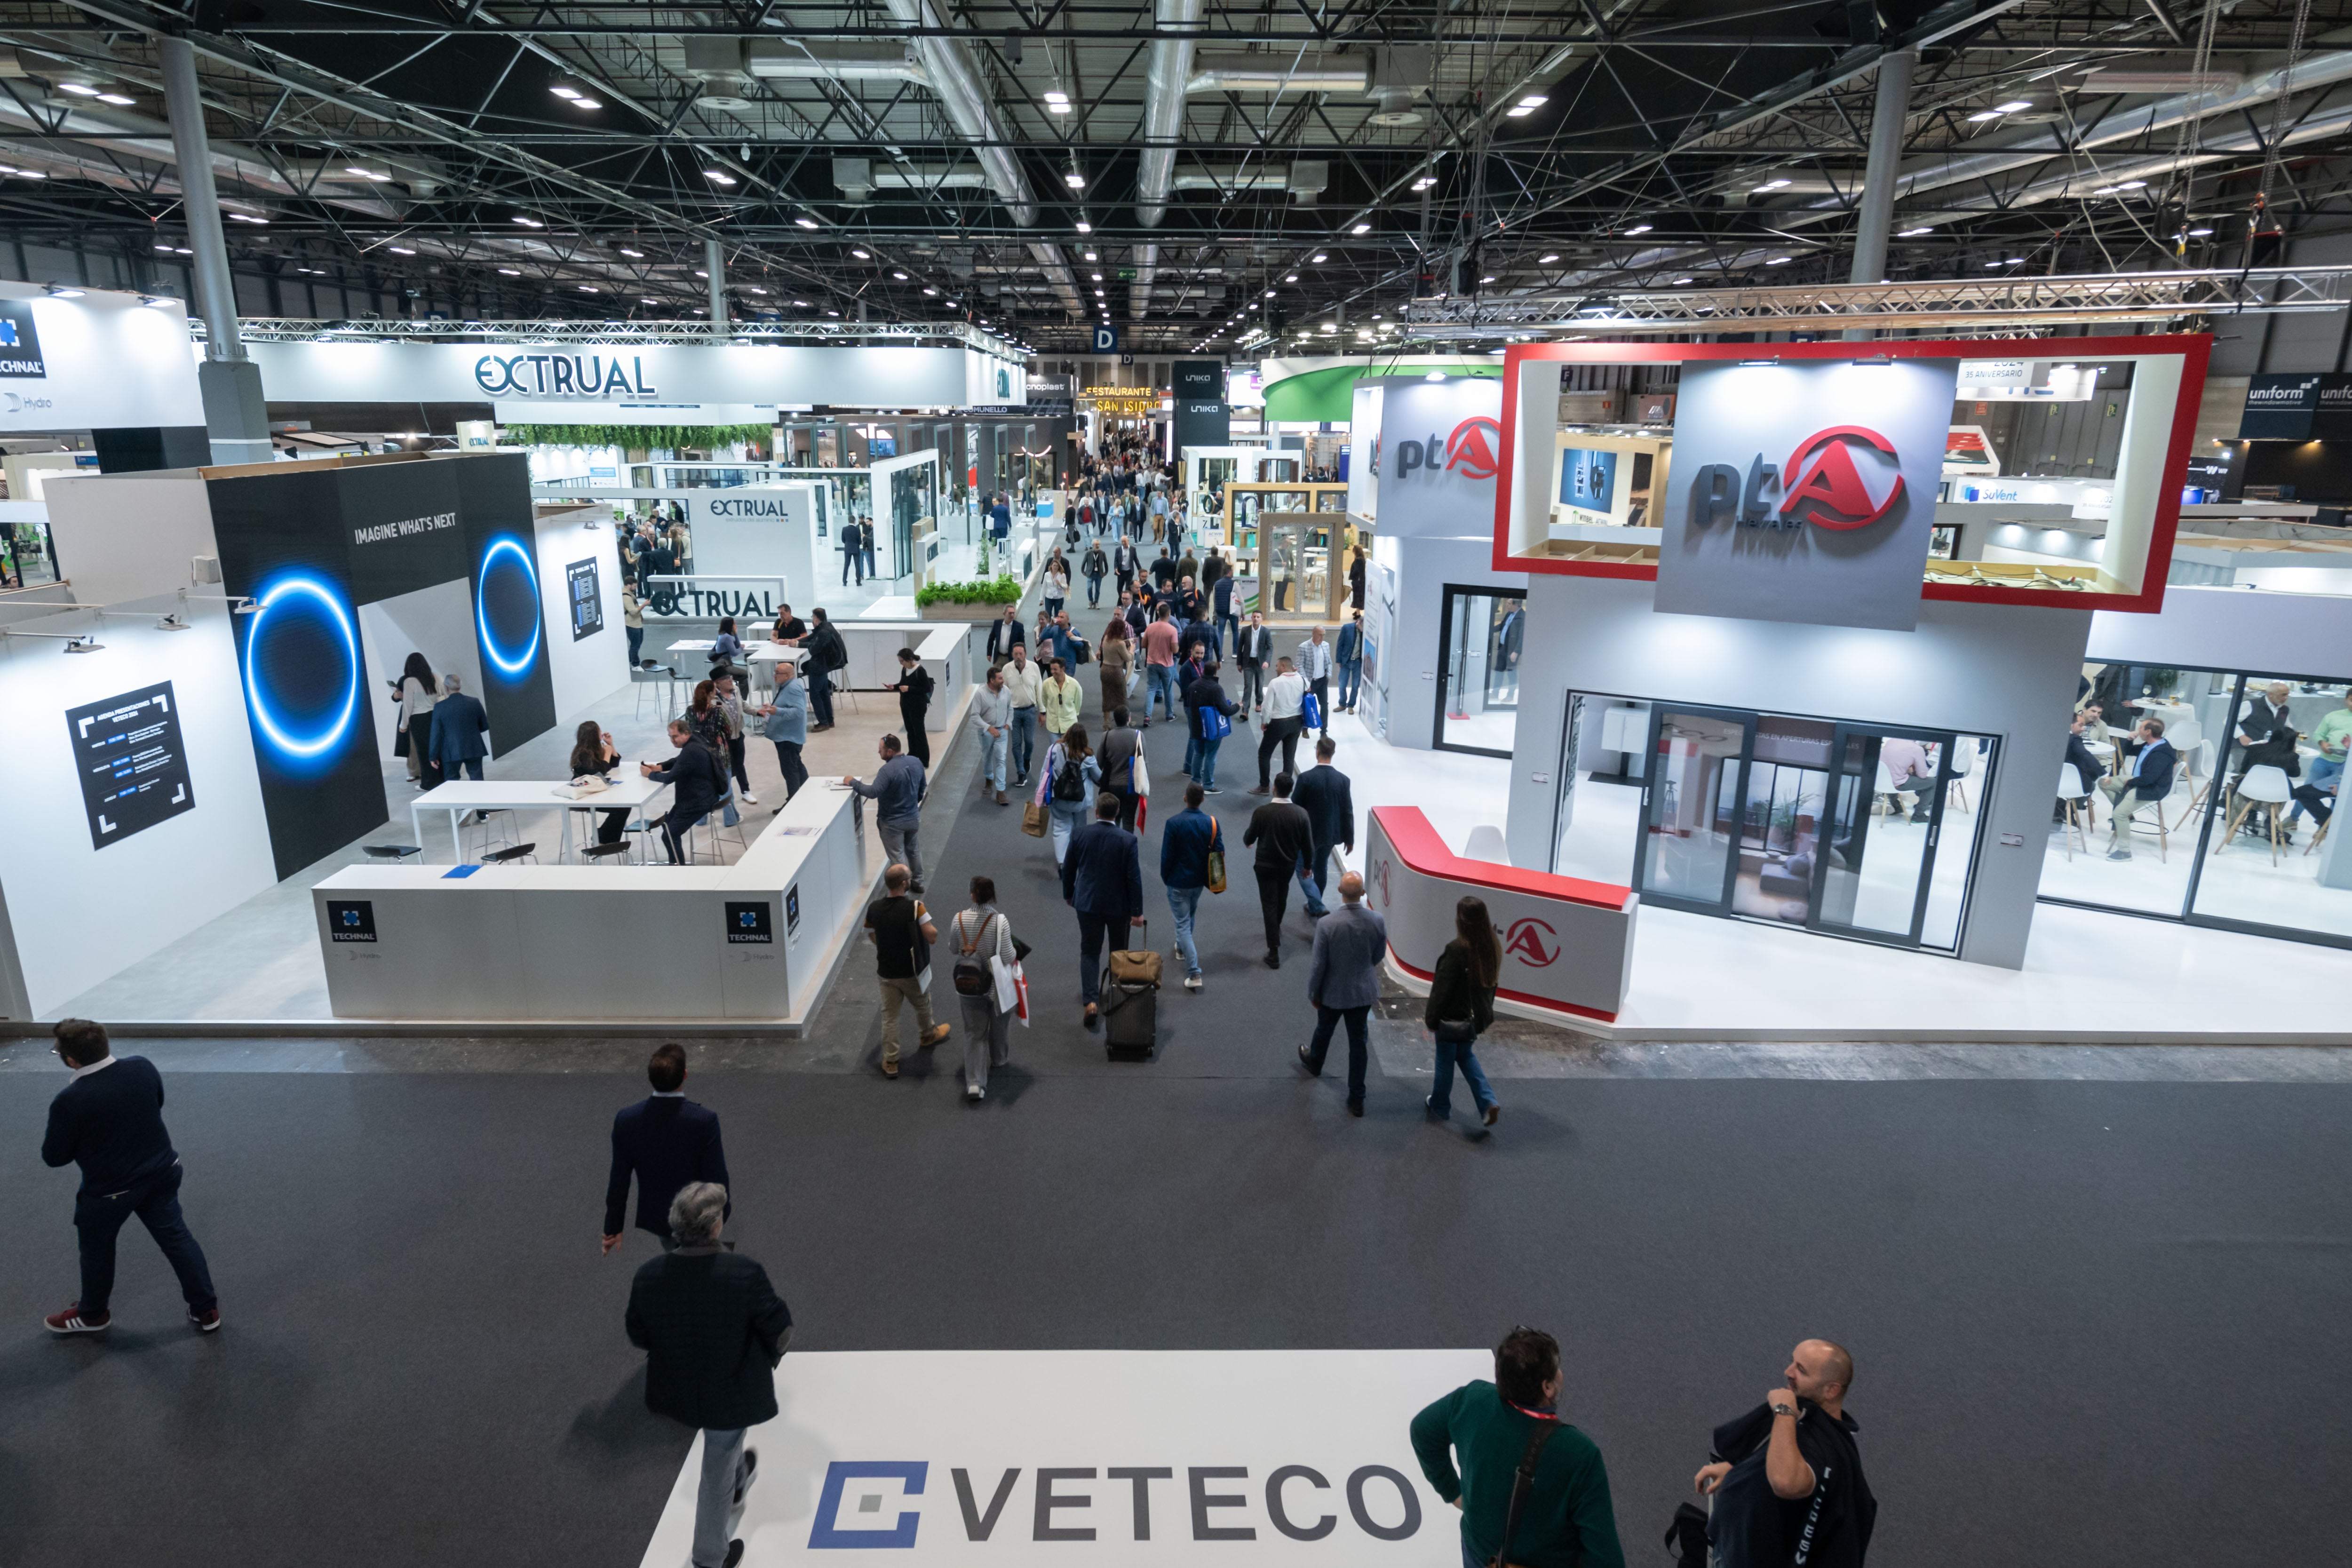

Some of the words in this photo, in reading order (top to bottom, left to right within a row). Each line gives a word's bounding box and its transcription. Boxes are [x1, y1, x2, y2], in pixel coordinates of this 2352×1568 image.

[1098, 330, 1113, 348] D
[1123, 354, 1131, 364] D
[475, 355, 655, 393] EXTRUAL
[1565, 371, 1570, 380] F
[2249, 385, 2304, 399] uniform
[24, 397, 52, 410] Hydro
[1097, 401, 1118, 411] SAN
[1983, 489, 2018, 501] SuVent
[711, 500, 788, 516] EXTRUAL
[355, 523, 398, 544] IMAGINE
[398, 517, 433, 535] WHAT'S
[434, 513, 455, 529] NEXT
[1780, 734, 1820, 745] APERTURAS
[950, 1464, 1422, 1541] VETECO
